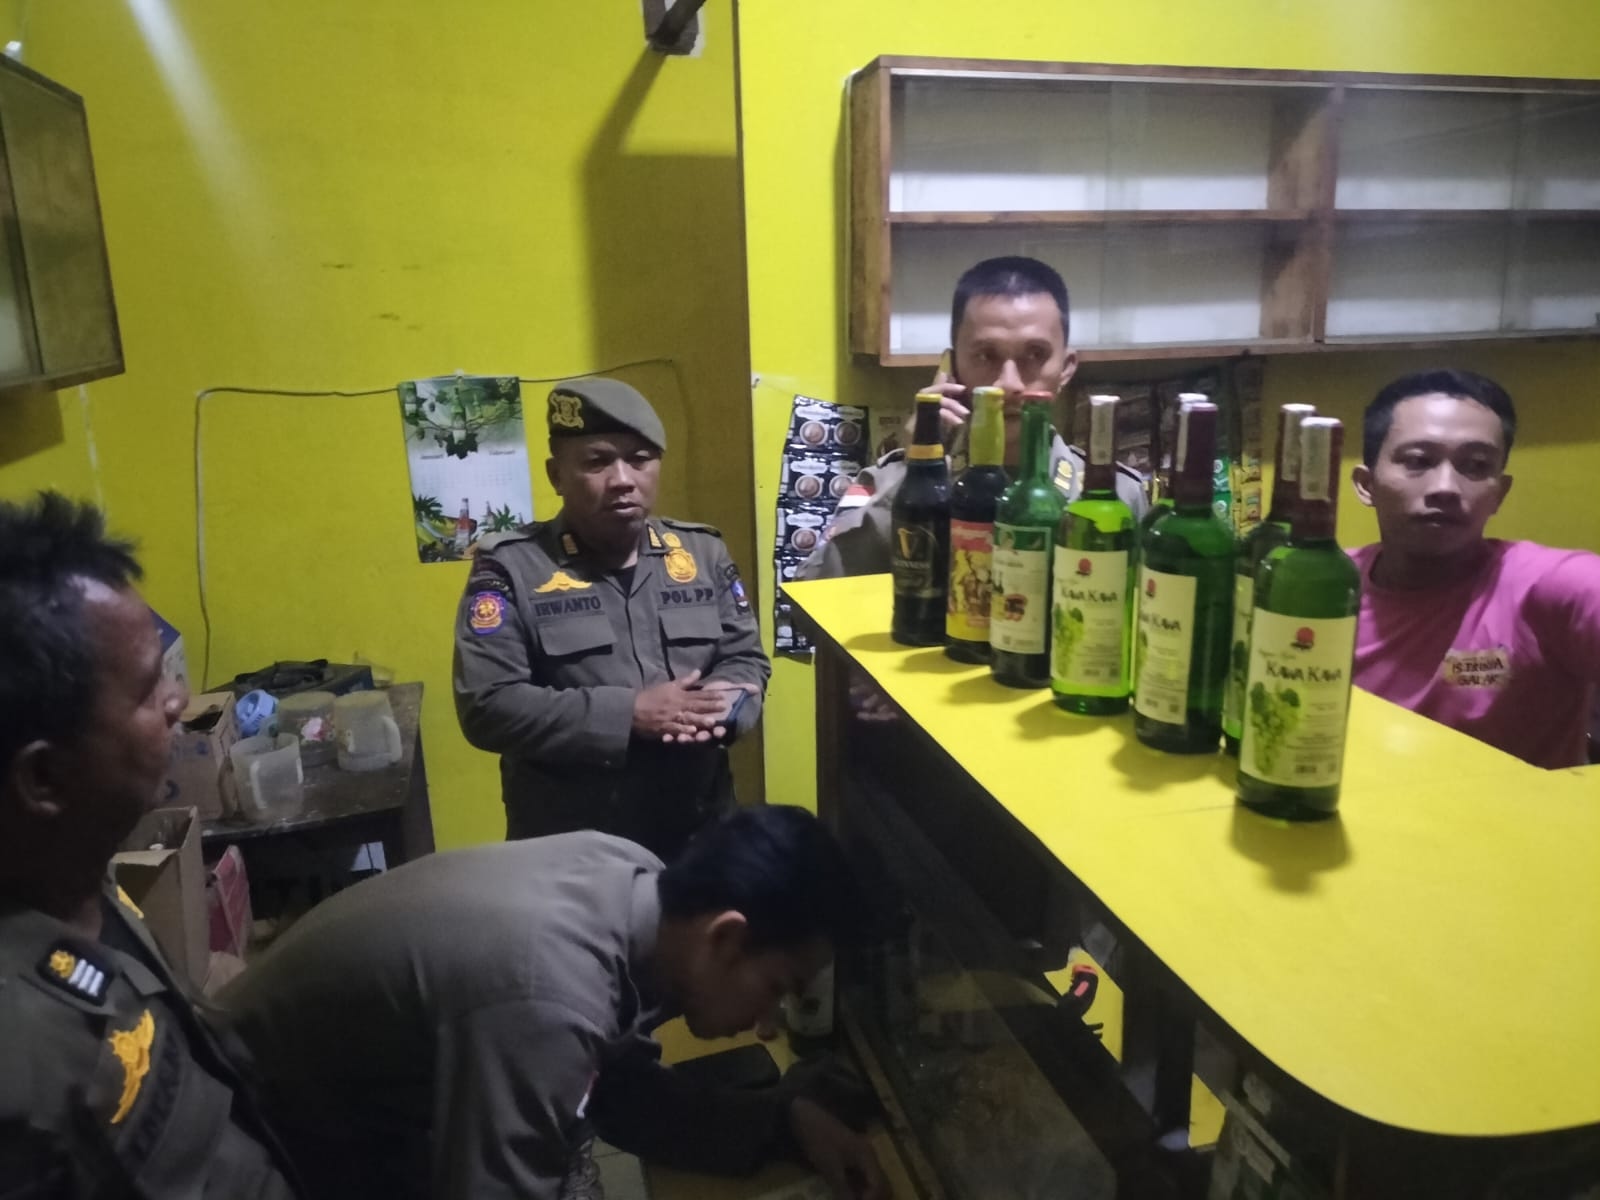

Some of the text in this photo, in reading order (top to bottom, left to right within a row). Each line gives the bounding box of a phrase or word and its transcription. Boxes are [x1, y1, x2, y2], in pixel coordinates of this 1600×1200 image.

[660, 588, 714, 605] POL PP
[535, 596, 601, 616] IRWANTO
